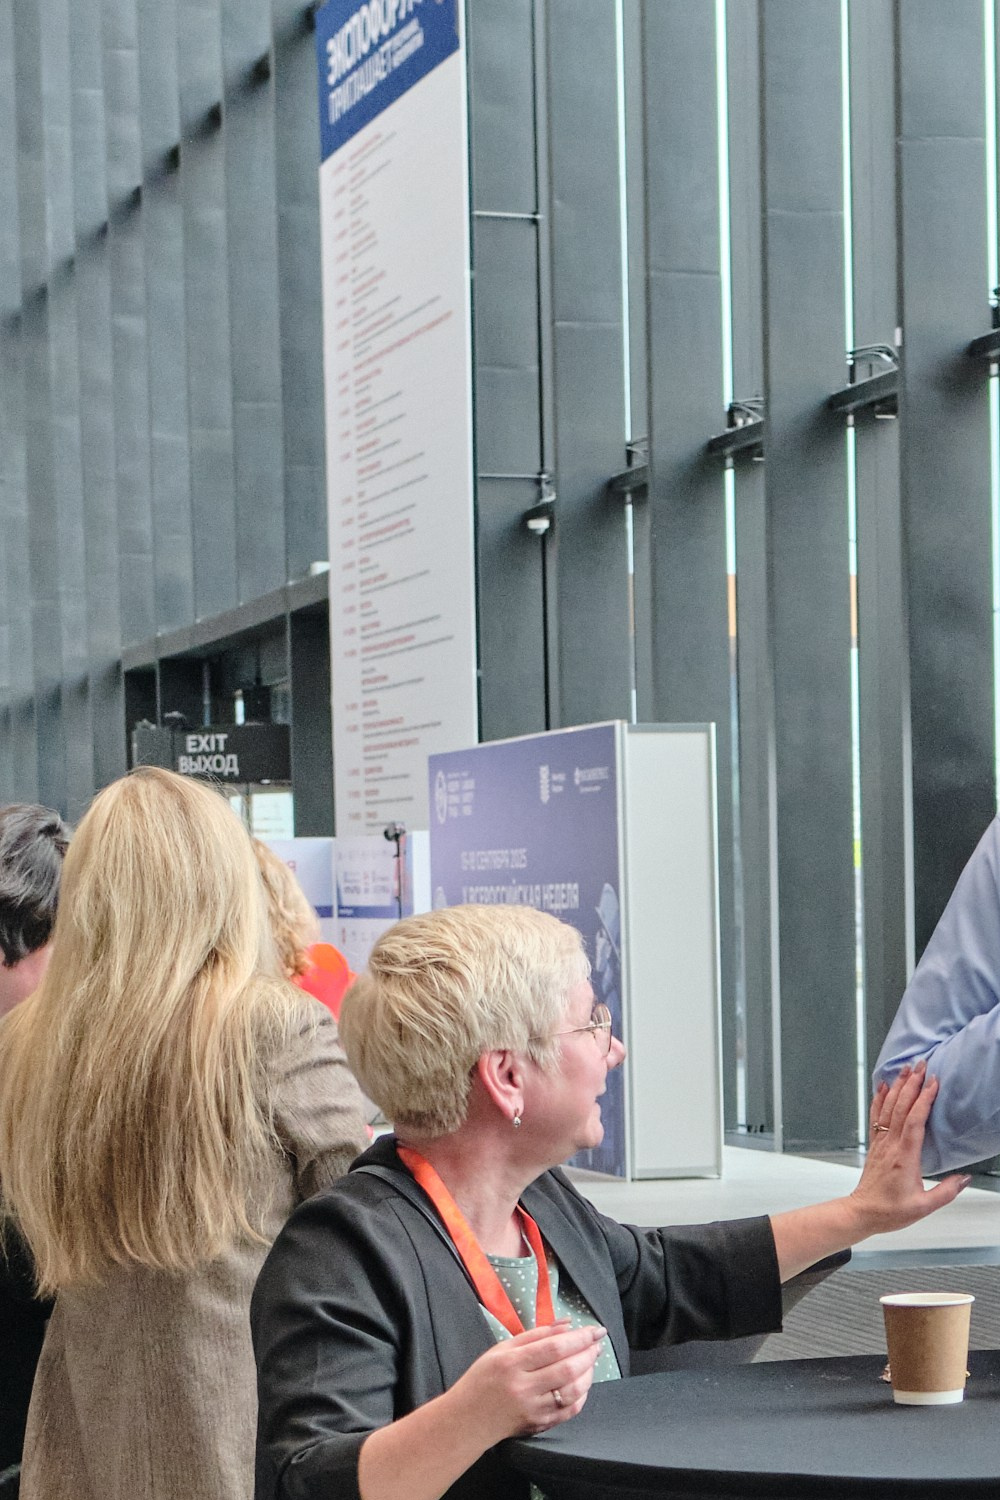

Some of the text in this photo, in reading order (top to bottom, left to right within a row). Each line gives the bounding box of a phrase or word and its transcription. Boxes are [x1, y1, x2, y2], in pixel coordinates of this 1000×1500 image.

[185, 733, 228, 753] EXIT
[178, 754, 240, 777] ВЫХОД
[542, 882, 579, 914] НЕДЕЛЯ
